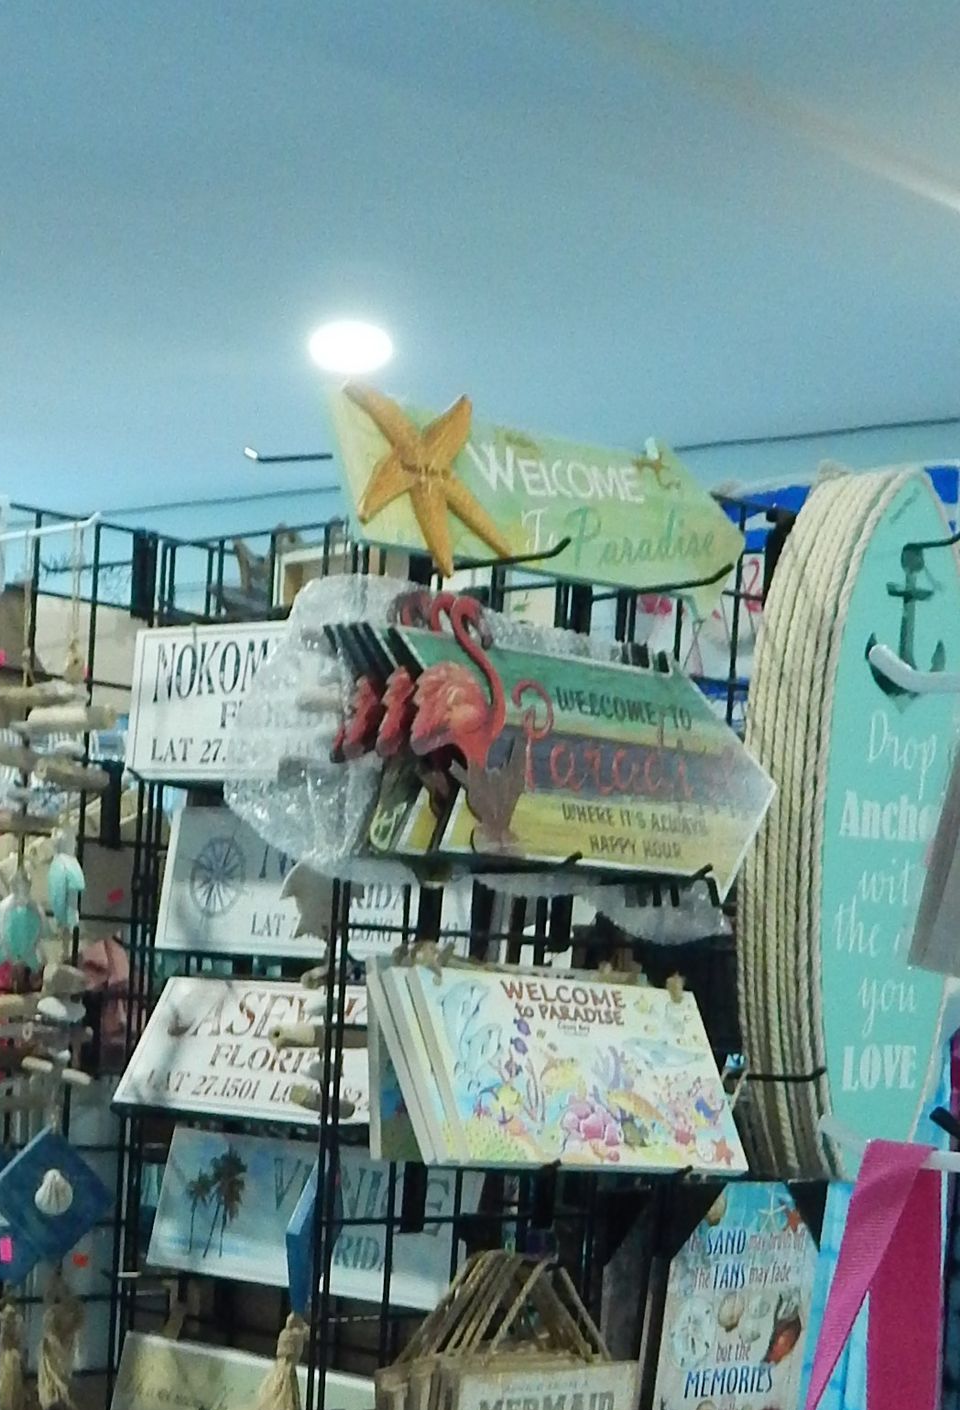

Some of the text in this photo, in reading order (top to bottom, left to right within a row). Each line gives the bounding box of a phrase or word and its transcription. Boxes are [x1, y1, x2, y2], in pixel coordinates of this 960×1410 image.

[464, 440, 644, 504] WELCOME
[568, 505, 714, 568] Paradise
[153, 638, 270, 703] NOKOM
[555, 685, 657, 726] WELCOME
[151, 738, 227, 763] LAT 27.
[511, 678, 738, 796] Paradi
[866, 710, 938, 801] Drop
[561, 802, 613, 827] WHERE
[839, 788, 941, 842] Ancho
[589, 836, 683, 859] HAPPY HOUR
[858, 858, 914, 906] wit
[250, 910, 287, 937] LAT
[831, 894, 880, 958] the
[500, 980, 627, 1010] WELCOME
[538, 1003, 626, 1027] PARADISE
[857, 974, 917, 1038] you
[192, 1073, 262, 1101] 27.1501
[841, 1043, 918, 1092] LOVE
[707, 1228, 748, 1257] SAND
[712, 1263, 746, 1291] TANS
[684, 1362, 774, 1400] MEMORIES
